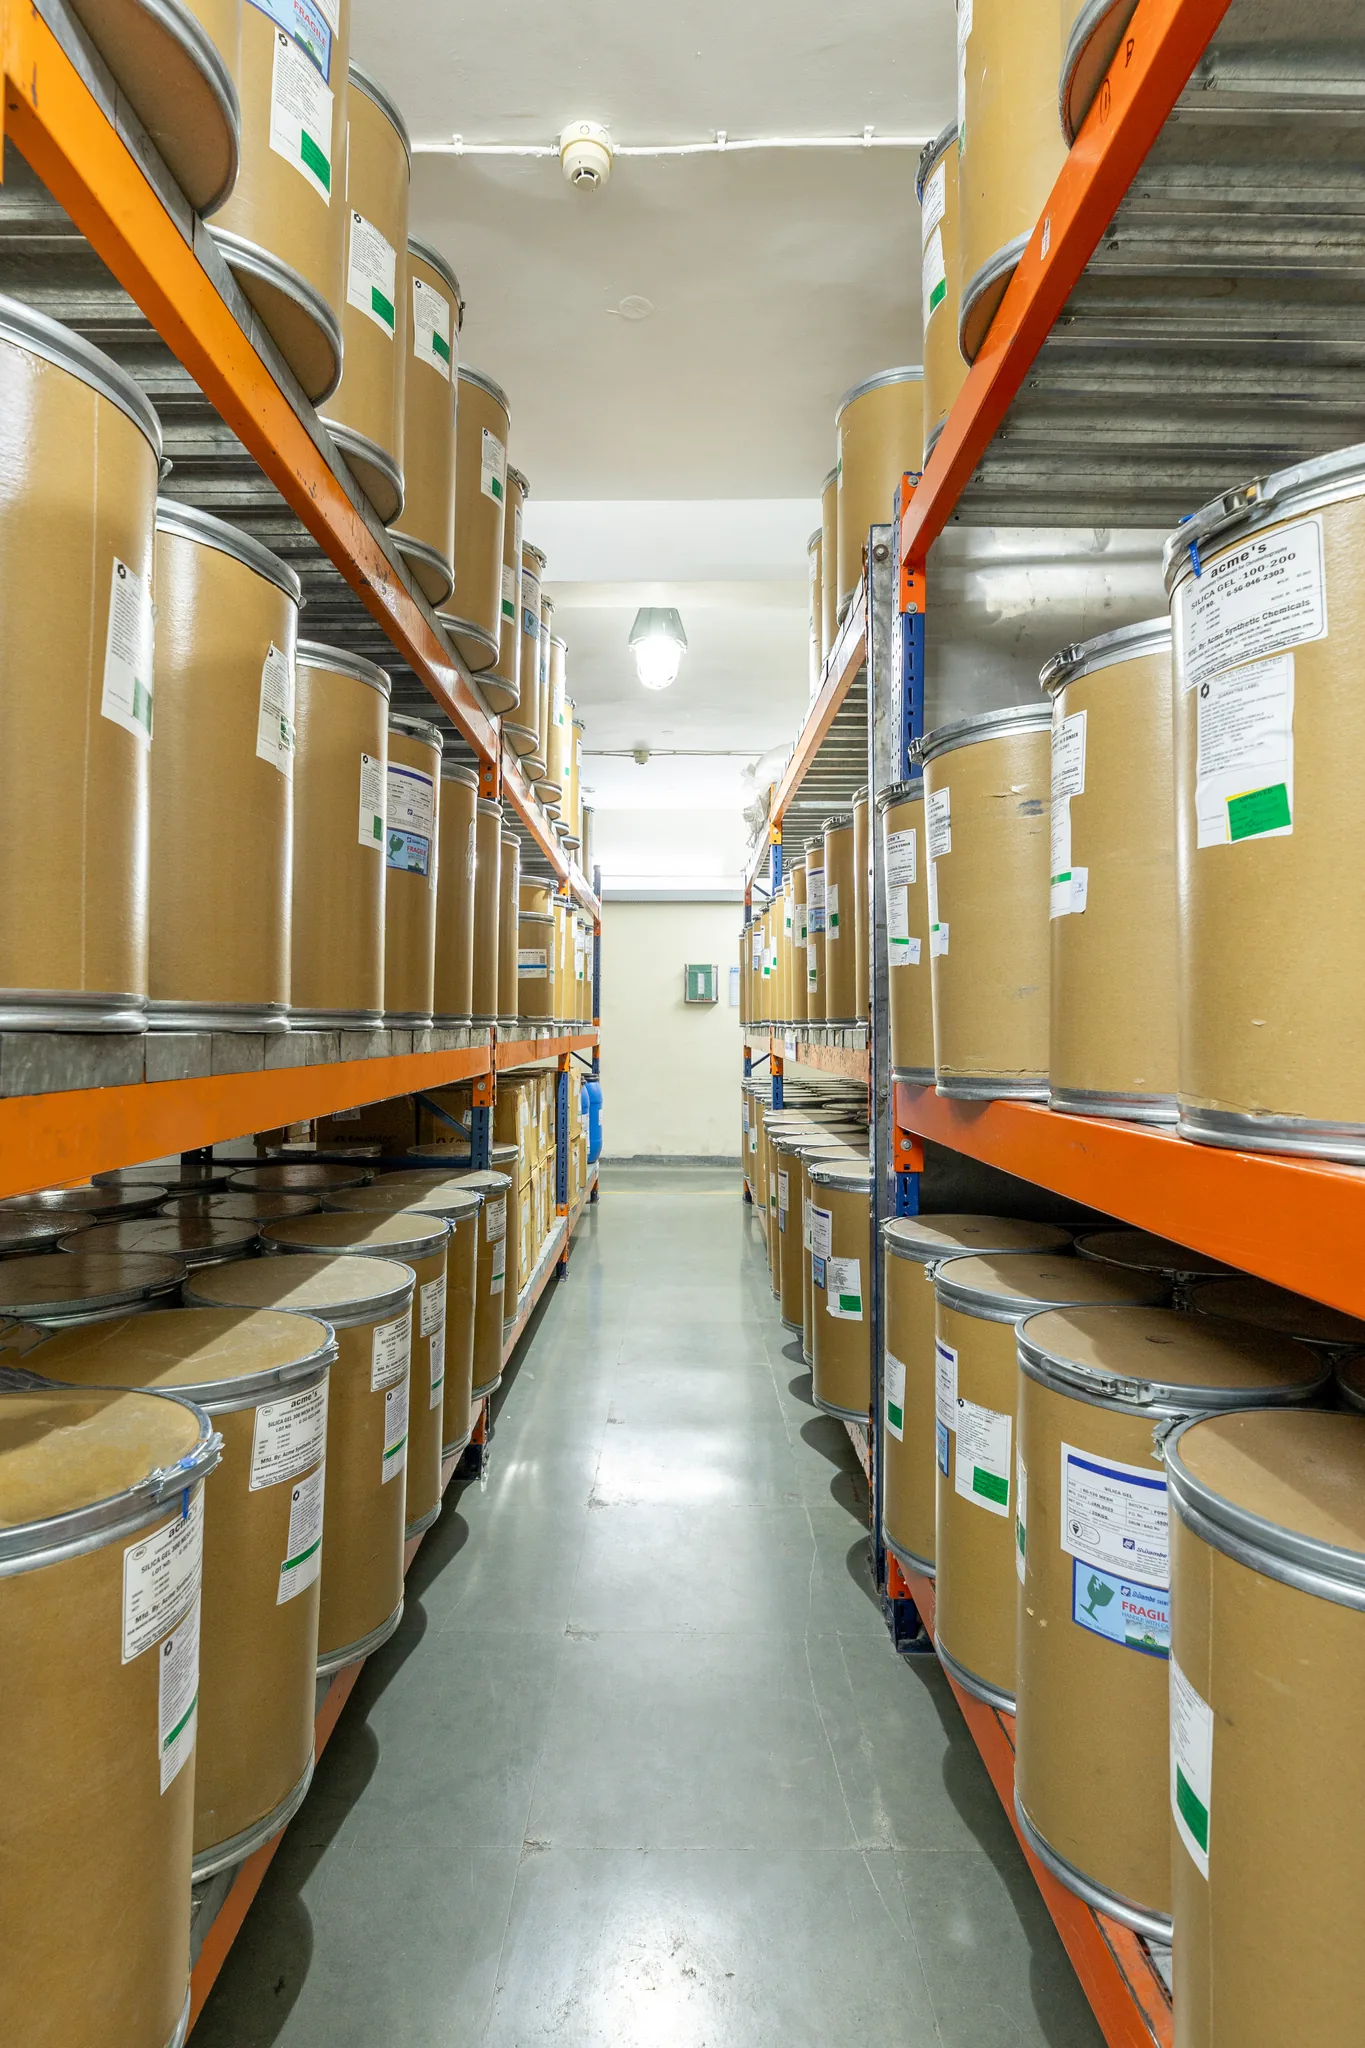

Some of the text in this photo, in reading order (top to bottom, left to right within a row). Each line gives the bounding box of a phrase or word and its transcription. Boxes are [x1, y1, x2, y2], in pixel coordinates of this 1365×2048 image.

[294, 0, 326, 49] FRAGILE
[1210, 543, 1267, 578] acme's
[1191, 588, 1215, 610] SILICA
[1217, 579, 1236, 592] GEL
[1196, 605, 1206, 615] LOT
[1207, 632, 1224, 645] Acme
[1225, 617, 1261, 637] Synthetic
[1261, 599, 1311, 621] Chemicals
[1244, 683, 1260, 693] LABEL
[407, 845, 426, 857] FRAGILE
[290, 1390, 319, 1408] acme's
[267, 1417, 284, 1428] SILICA
[284, 1415, 293, 1424] GEL
[275, 1425, 285, 1433] LOT
[273, 1454, 282, 1462] By:
[282, 1449, 295, 1457] Acme
[1104, 1486, 1133, 1499] SILICA GEL
[141, 1555, 161, 1574] SILICA
[161, 1549, 171, 1561] GEL
[151, 1565, 162, 1577] LOT
[135, 1611, 150, 1624] Mfd.
[151, 1602, 161, 1614] By:
[161, 1591, 177, 1605] Acme
[1121, 1601, 1168, 1623] FRAGIL
